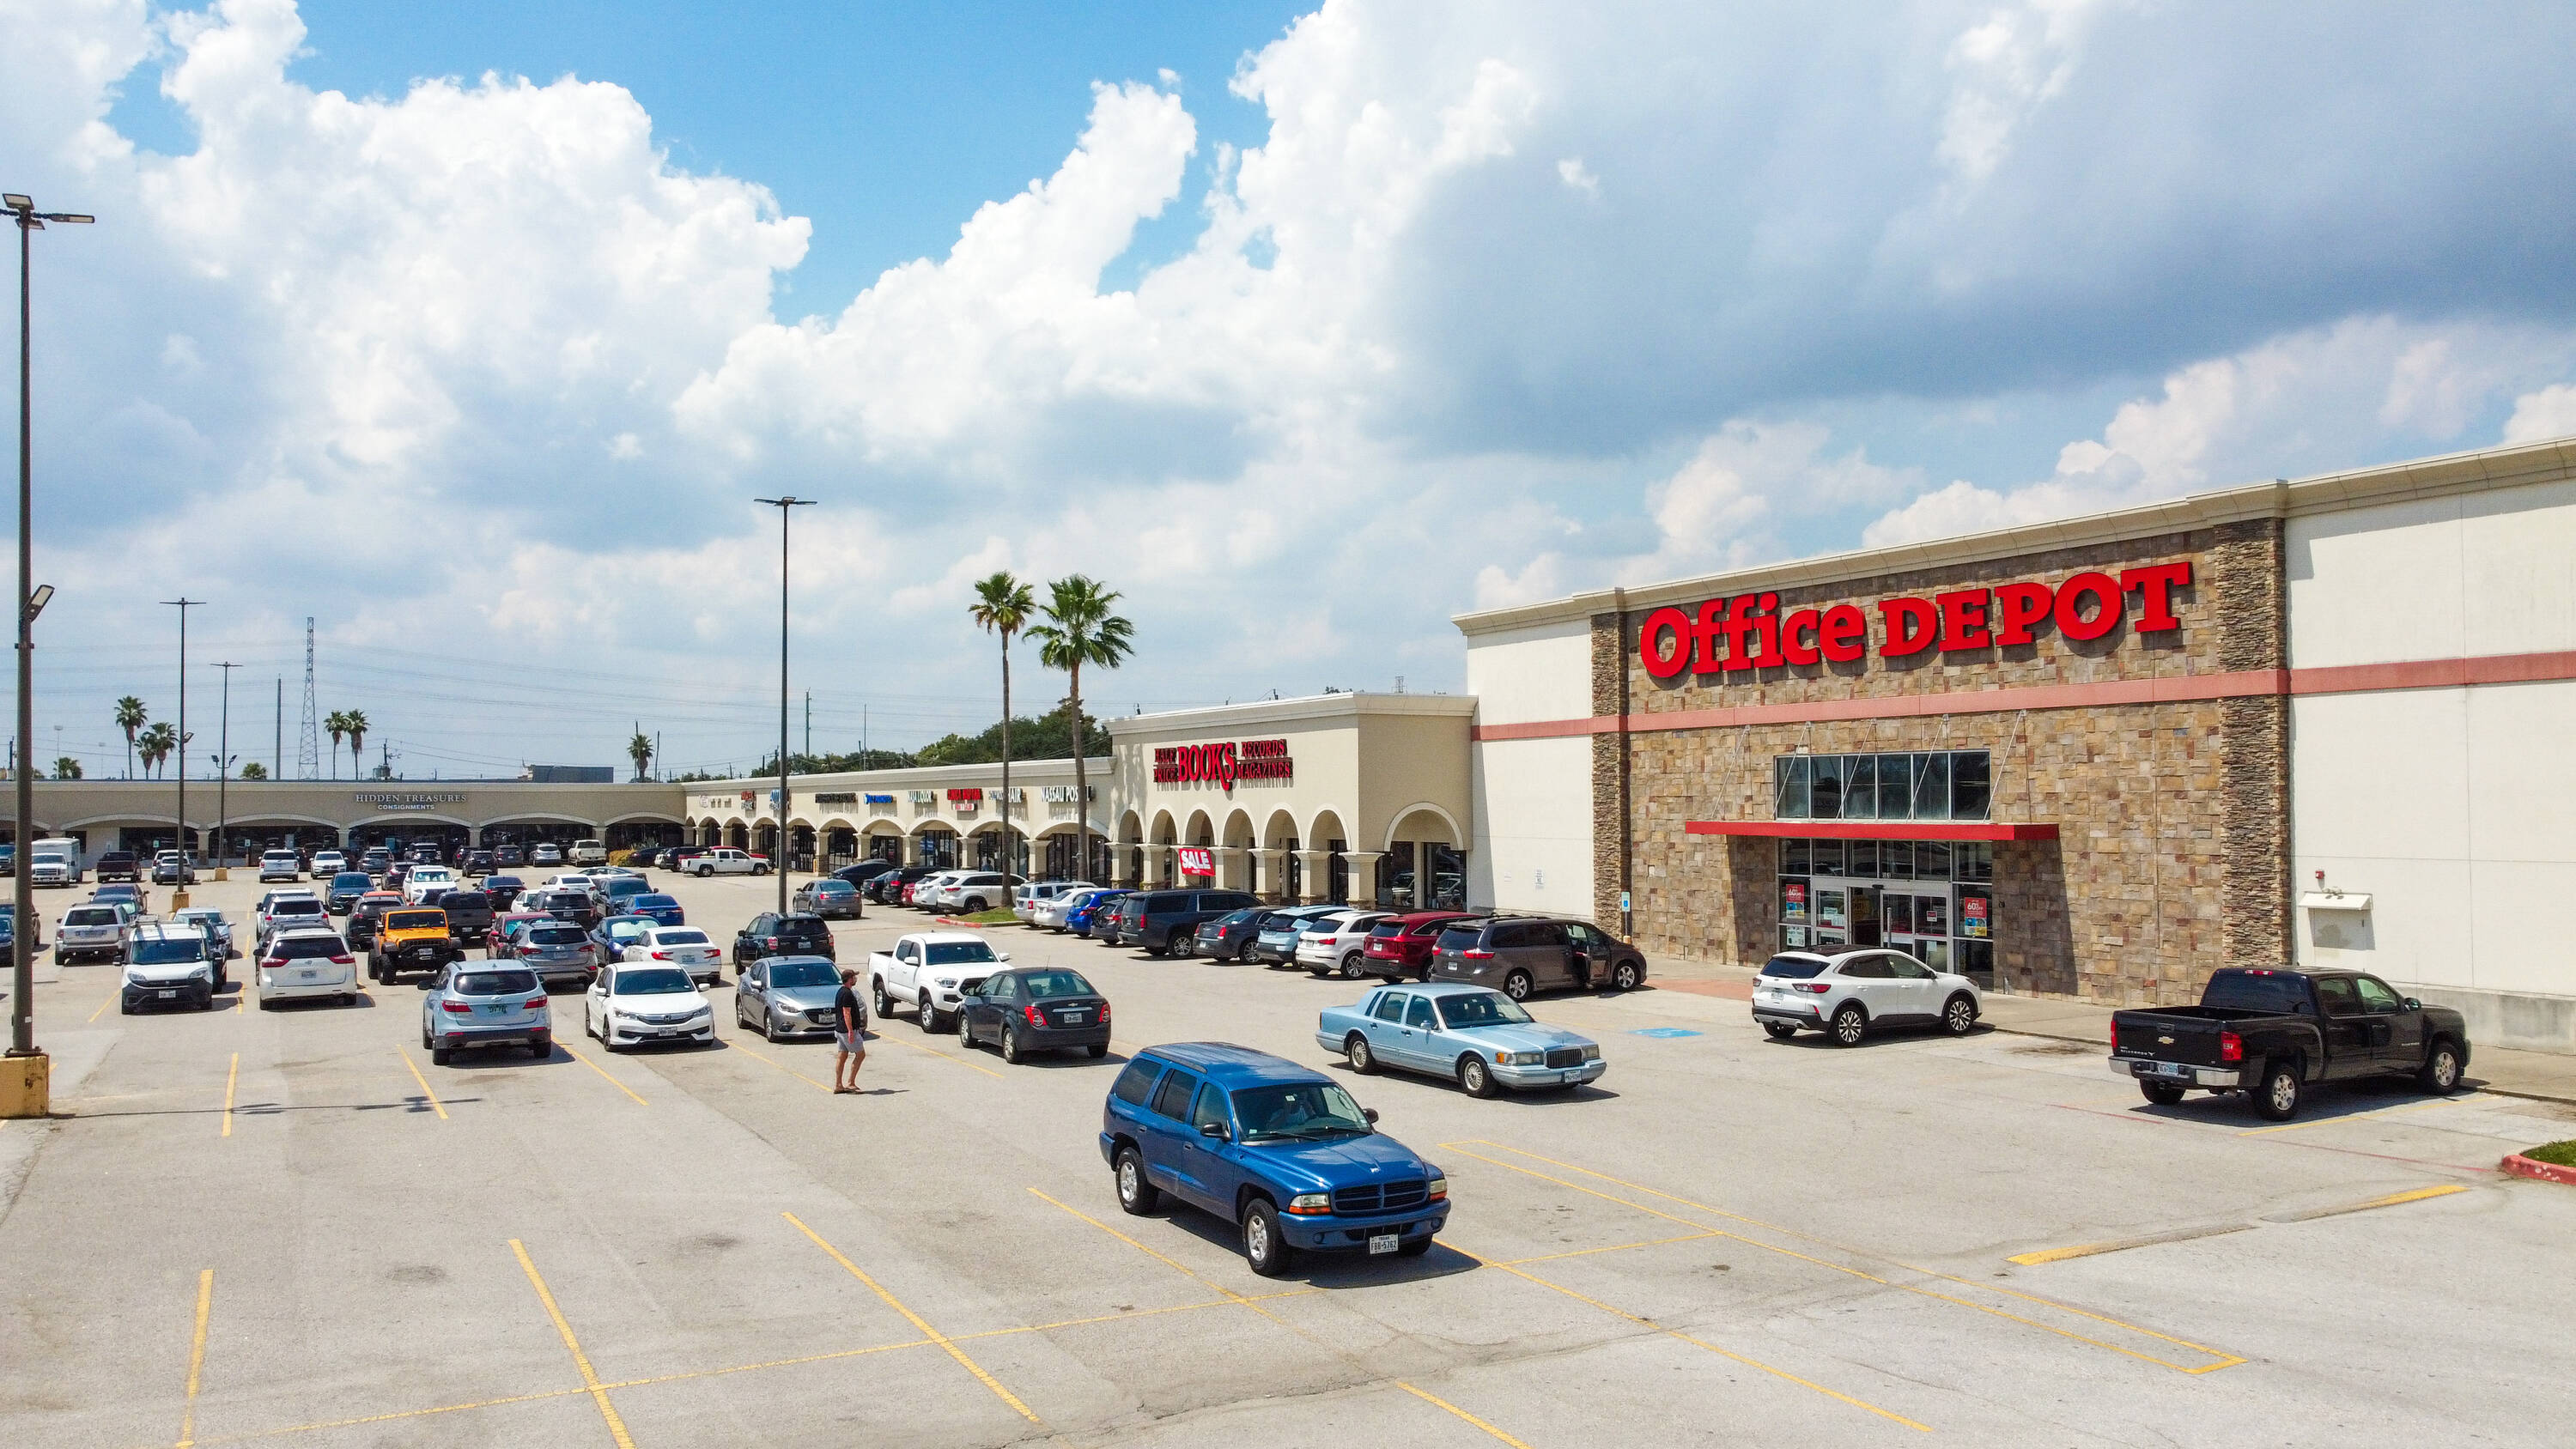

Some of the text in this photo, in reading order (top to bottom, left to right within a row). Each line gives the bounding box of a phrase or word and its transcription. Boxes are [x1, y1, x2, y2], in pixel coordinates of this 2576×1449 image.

[1640, 561, 2193, 679] Office DEPOT
[1154, 749, 1176, 763] HALF
[1241, 739, 1287, 757] RECORDS
[1153, 768, 1179, 783] PRICE
[1177, 742, 1236, 791] BOOKS
[1236, 762, 1292, 779] MAGAZINES
[355, 794, 467, 803] HIDDEN TREASURES
[1042, 785, 1091, 803] NASSAU POSL
[1181, 850, 1212, 870] SALE
